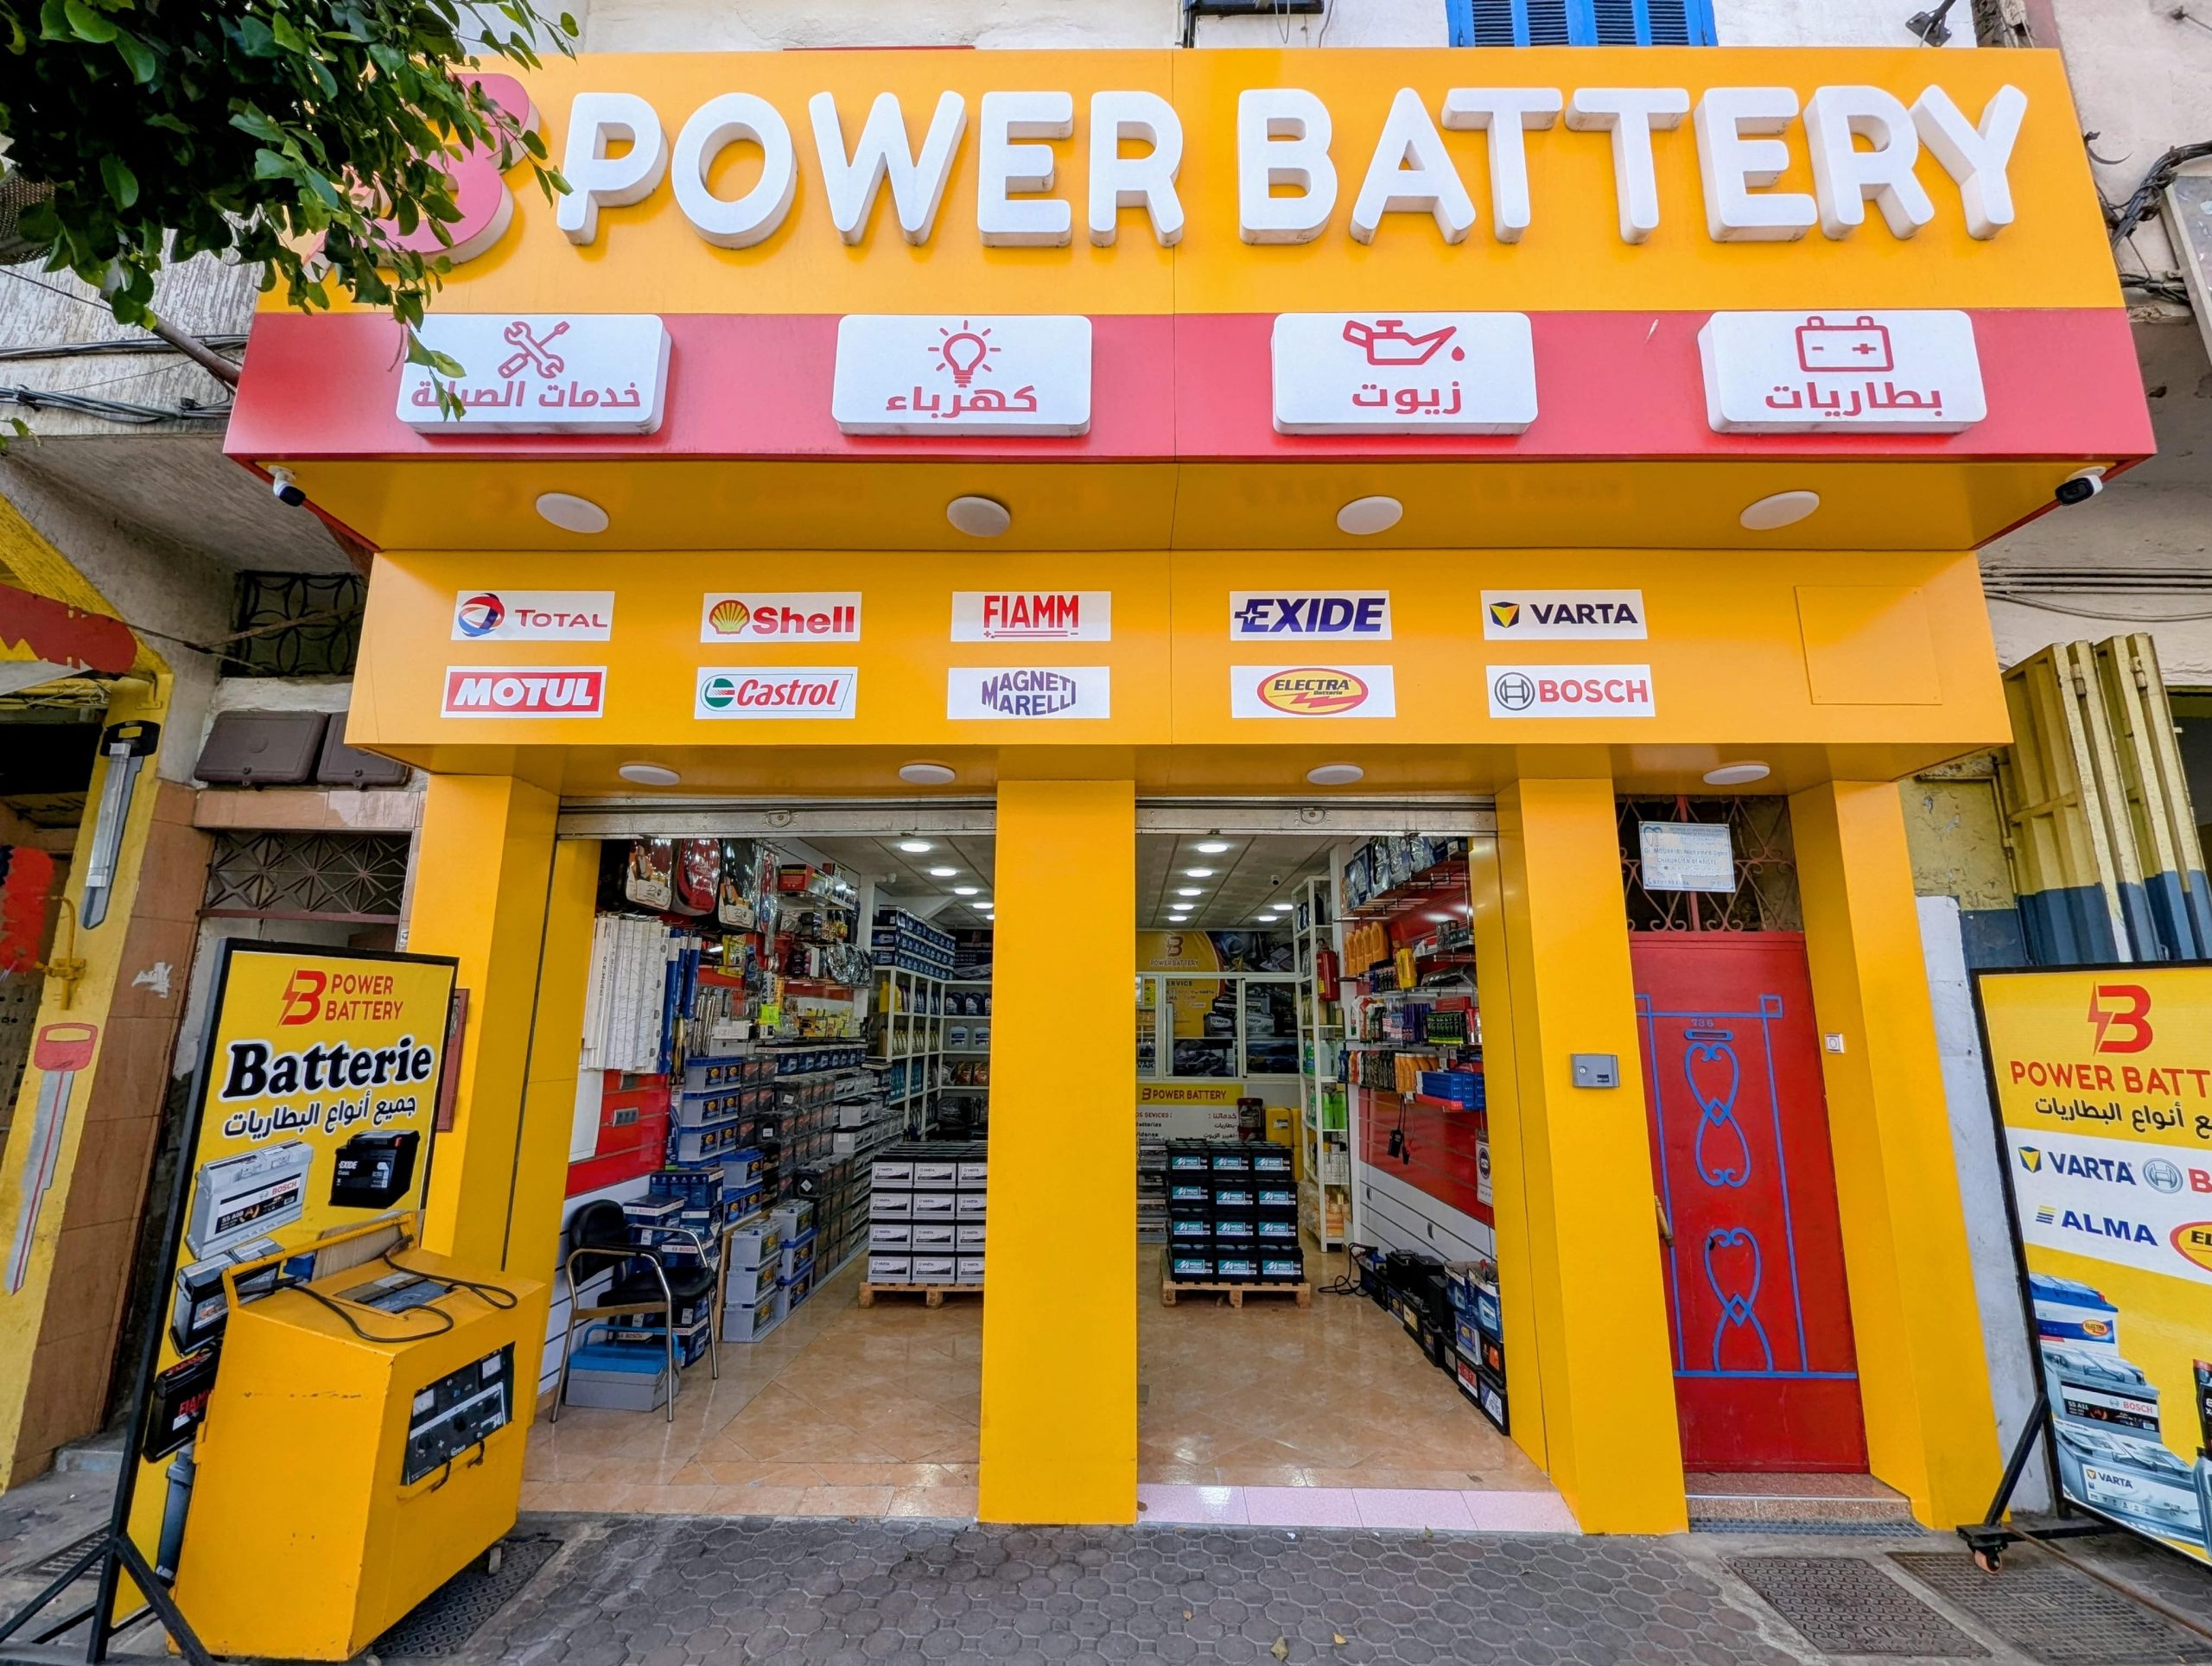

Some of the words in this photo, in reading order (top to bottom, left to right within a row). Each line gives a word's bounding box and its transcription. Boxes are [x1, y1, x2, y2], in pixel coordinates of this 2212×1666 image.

[556, 90, 1185, 248] POWER
[1238, 84, 2028, 245] BATTERY
[411, 380, 525, 407] الصياة
[538, 381, 640, 407] خدمات
[885, 384, 1037, 417] كهرباء
[1351, 380, 1462, 415] زيوت
[1765, 380, 1942, 417] بطاريات
[514, 608, 608, 628] TOTAL
[752, 606, 855, 635] Shell
[983, 595, 1079, 628] FIAMM
[1234, 598, 1386, 633] EXIDE
[1529, 603, 1638, 624] VARTA
[453, 677, 595, 707] MOTUL
[736, 678, 840, 707] Castrol
[982, 671, 1076, 705] MAGNETI
[982, 683, 1076, 715] MARELLI
[1274, 679, 1350, 690] ELECTRA
[1538, 679, 1649, 703] BOSCH
[331, 974, 394, 995] POWER
[325, 1000, 404, 1022] BATTERY
[221, 1037, 432, 1099] Batterie
[2010, 1061, 2115, 1092] POWER
[373, 1095, 416, 1125] جميع
[1153, 1090, 1185, 1099] POWER
[1187, 1090, 1227, 1100] BATTERY
[225, 1103, 321, 1140] البطاريات
[325, 1090, 372, 1133] أنواع
[2035, 1097, 2122, 1125] البطاريات
[2133, 1102, 2184, 1133] أنواع
[2047, 1151, 2137, 1186] VARTA
[271, 1180, 297, 1196] BOSCH
[2061, 1210, 2159, 1247] ALMA
[2123, 1401, 2153, 1414] BOSCH
[2098, 1472, 2133, 1489] VARTA
